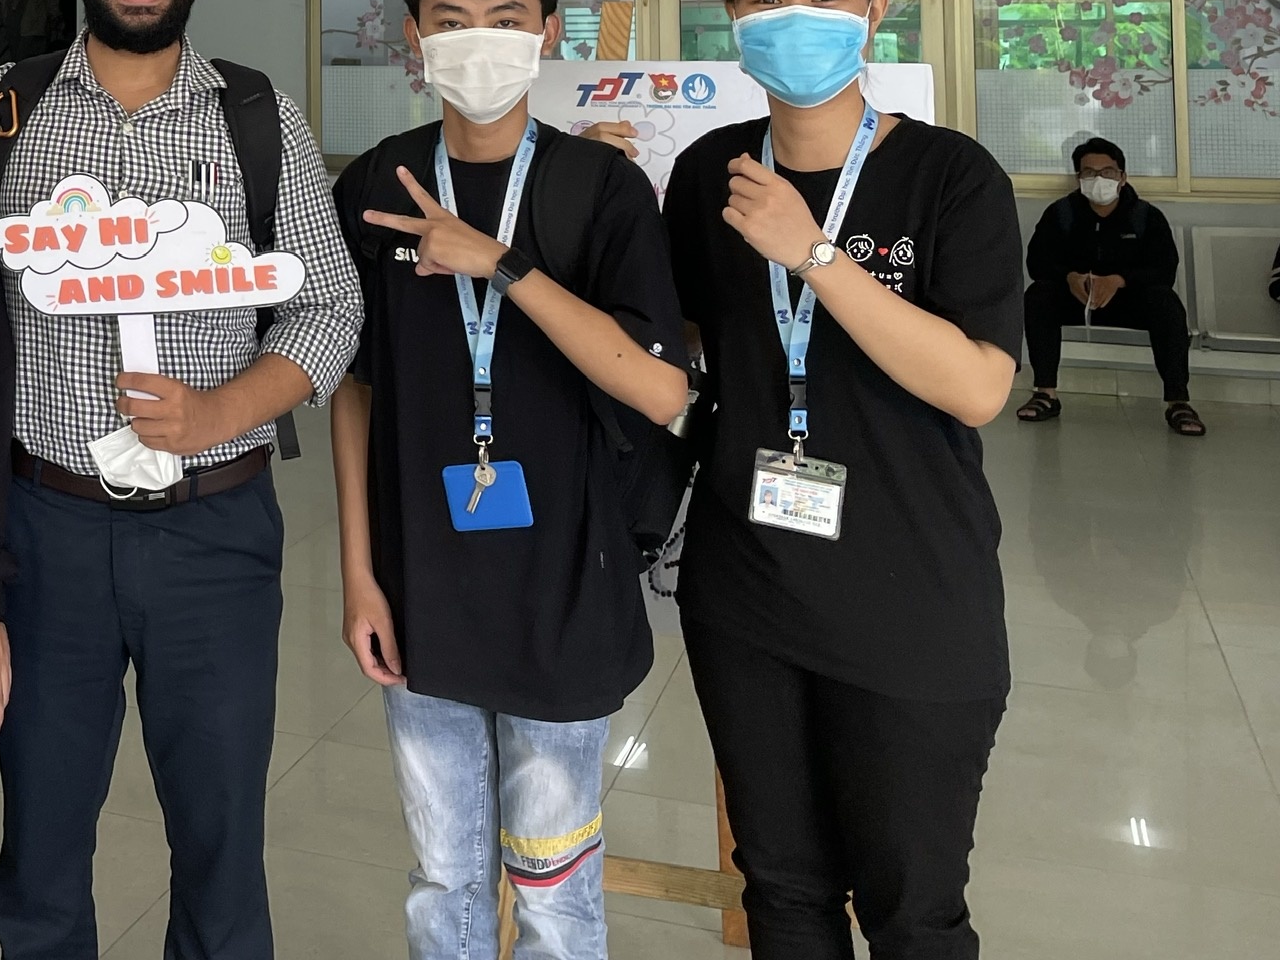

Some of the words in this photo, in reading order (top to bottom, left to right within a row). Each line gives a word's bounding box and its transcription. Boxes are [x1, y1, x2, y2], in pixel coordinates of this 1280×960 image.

[576, 72, 645, 107] TDT
[4, 223, 88, 254] SAY
[98, 216, 149, 246] HI
[58, 274, 144, 305] AND
[156, 264, 278, 298] SMILE
